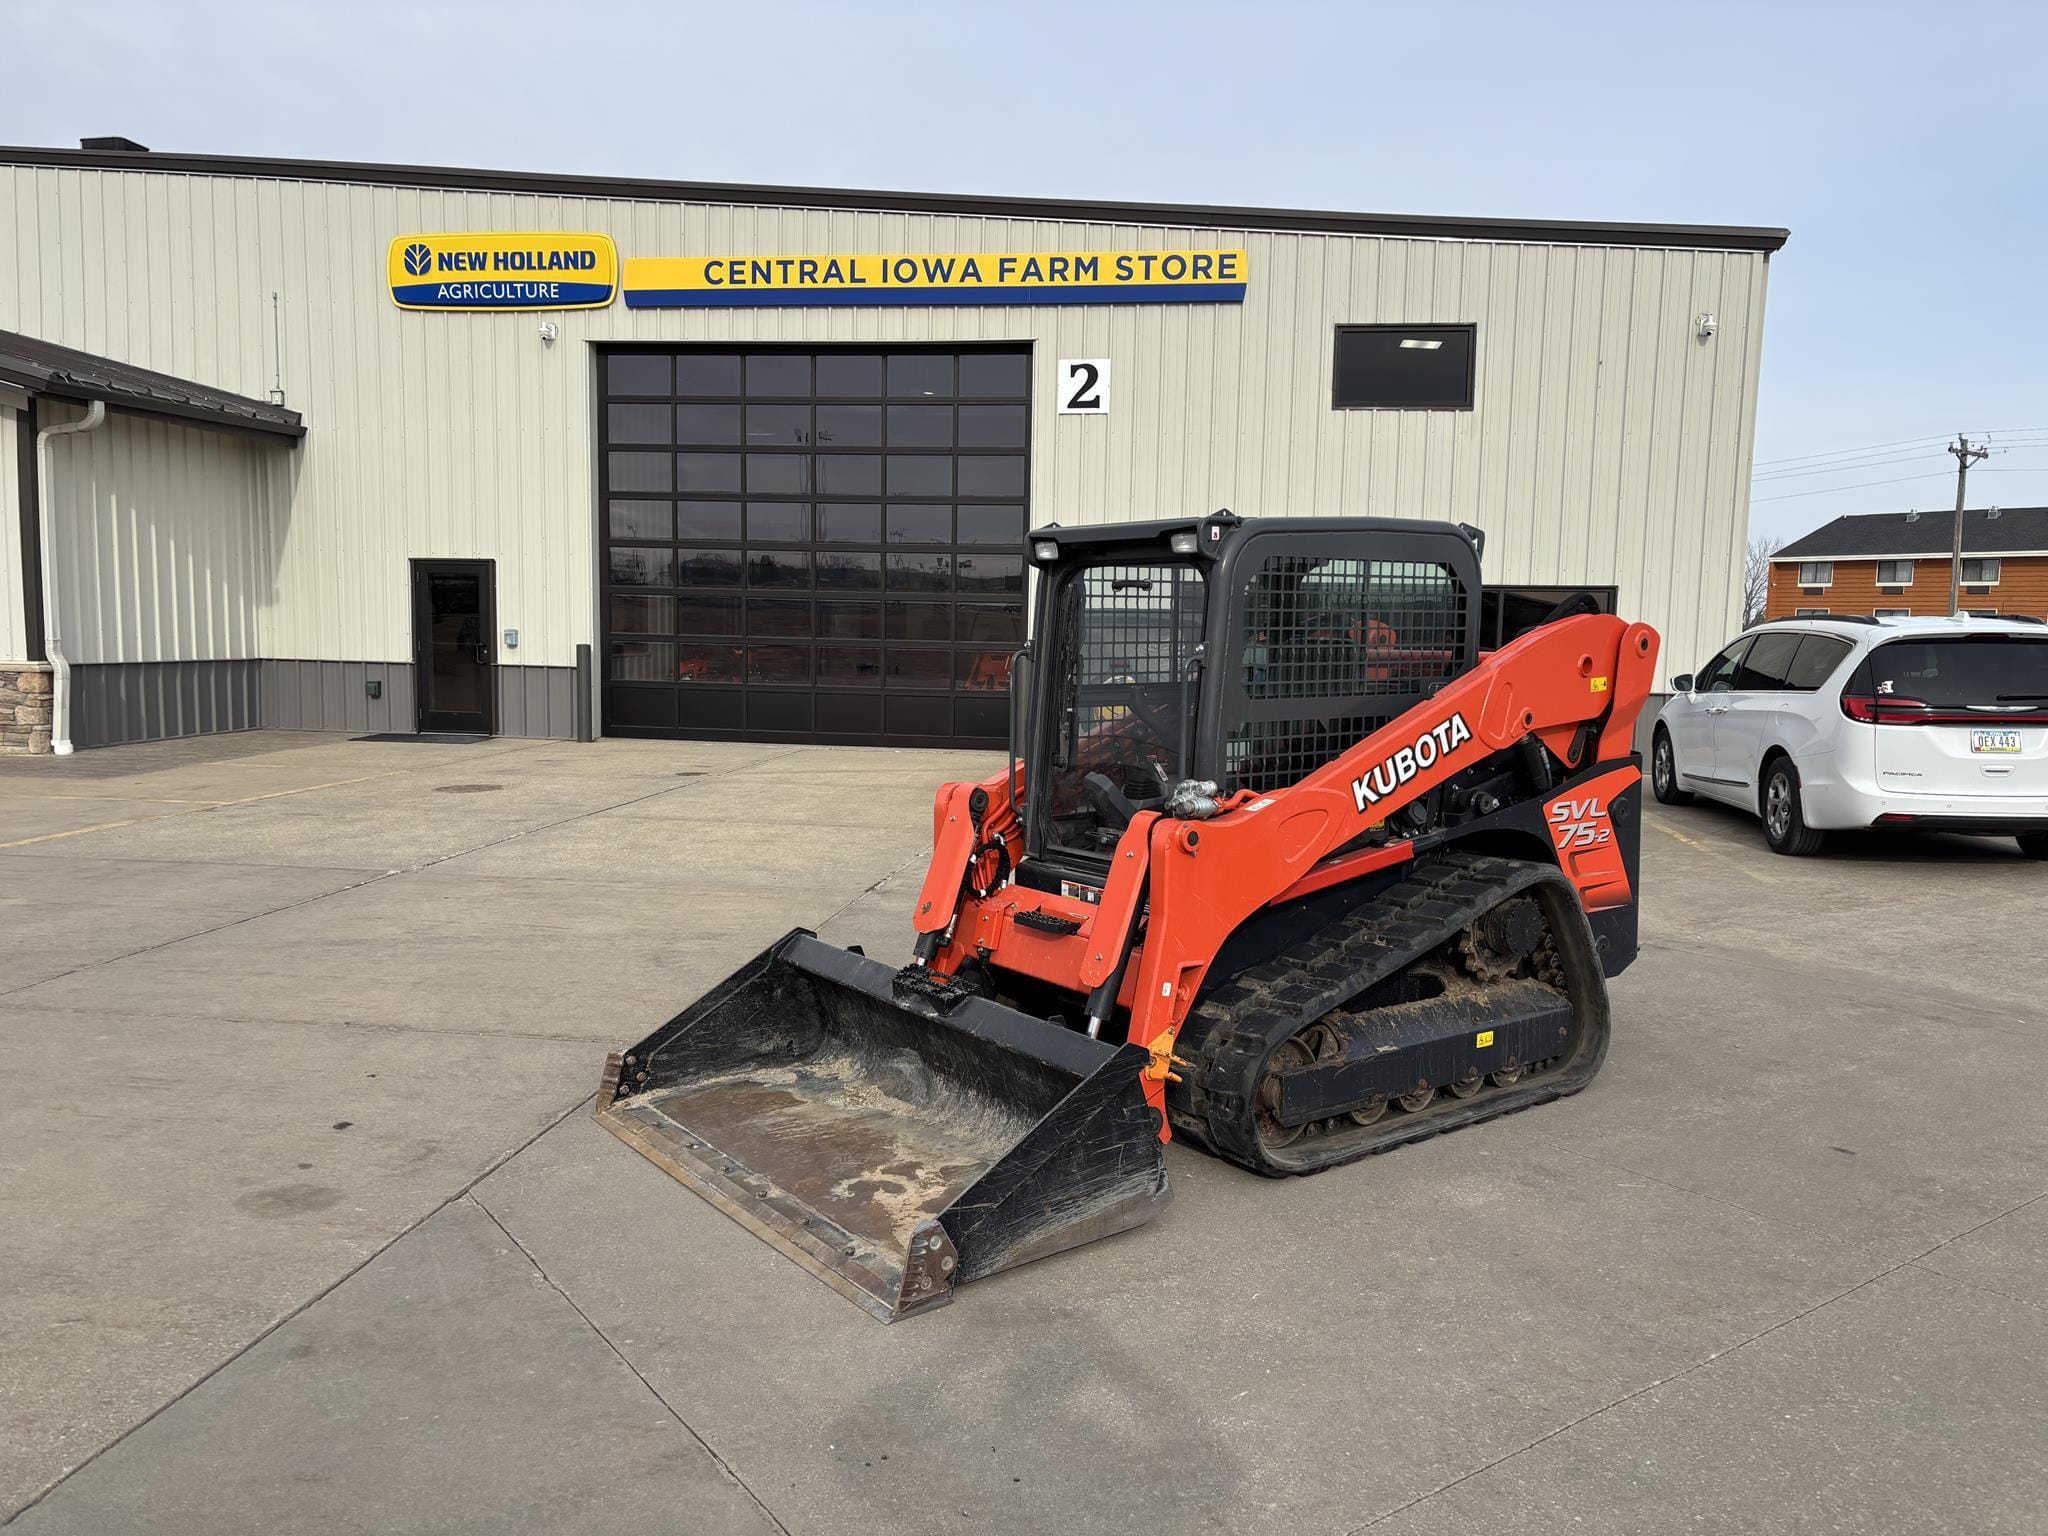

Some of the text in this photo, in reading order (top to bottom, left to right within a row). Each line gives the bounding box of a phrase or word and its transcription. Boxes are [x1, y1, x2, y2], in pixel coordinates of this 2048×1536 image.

[438, 250, 596, 272] NEW HOLLAND
[704, 254, 1237, 285] CENTRAL IOWA FARM STORE
[437, 283, 560, 299] AGRICULTURE
[1067, 363, 1100, 409] 2
[1998, 736, 2016, 748] 443
[1351, 711, 1473, 814] KUBOTA
[1549, 798, 1607, 824] SVL
[1558, 821, 1610, 849] 75-2
